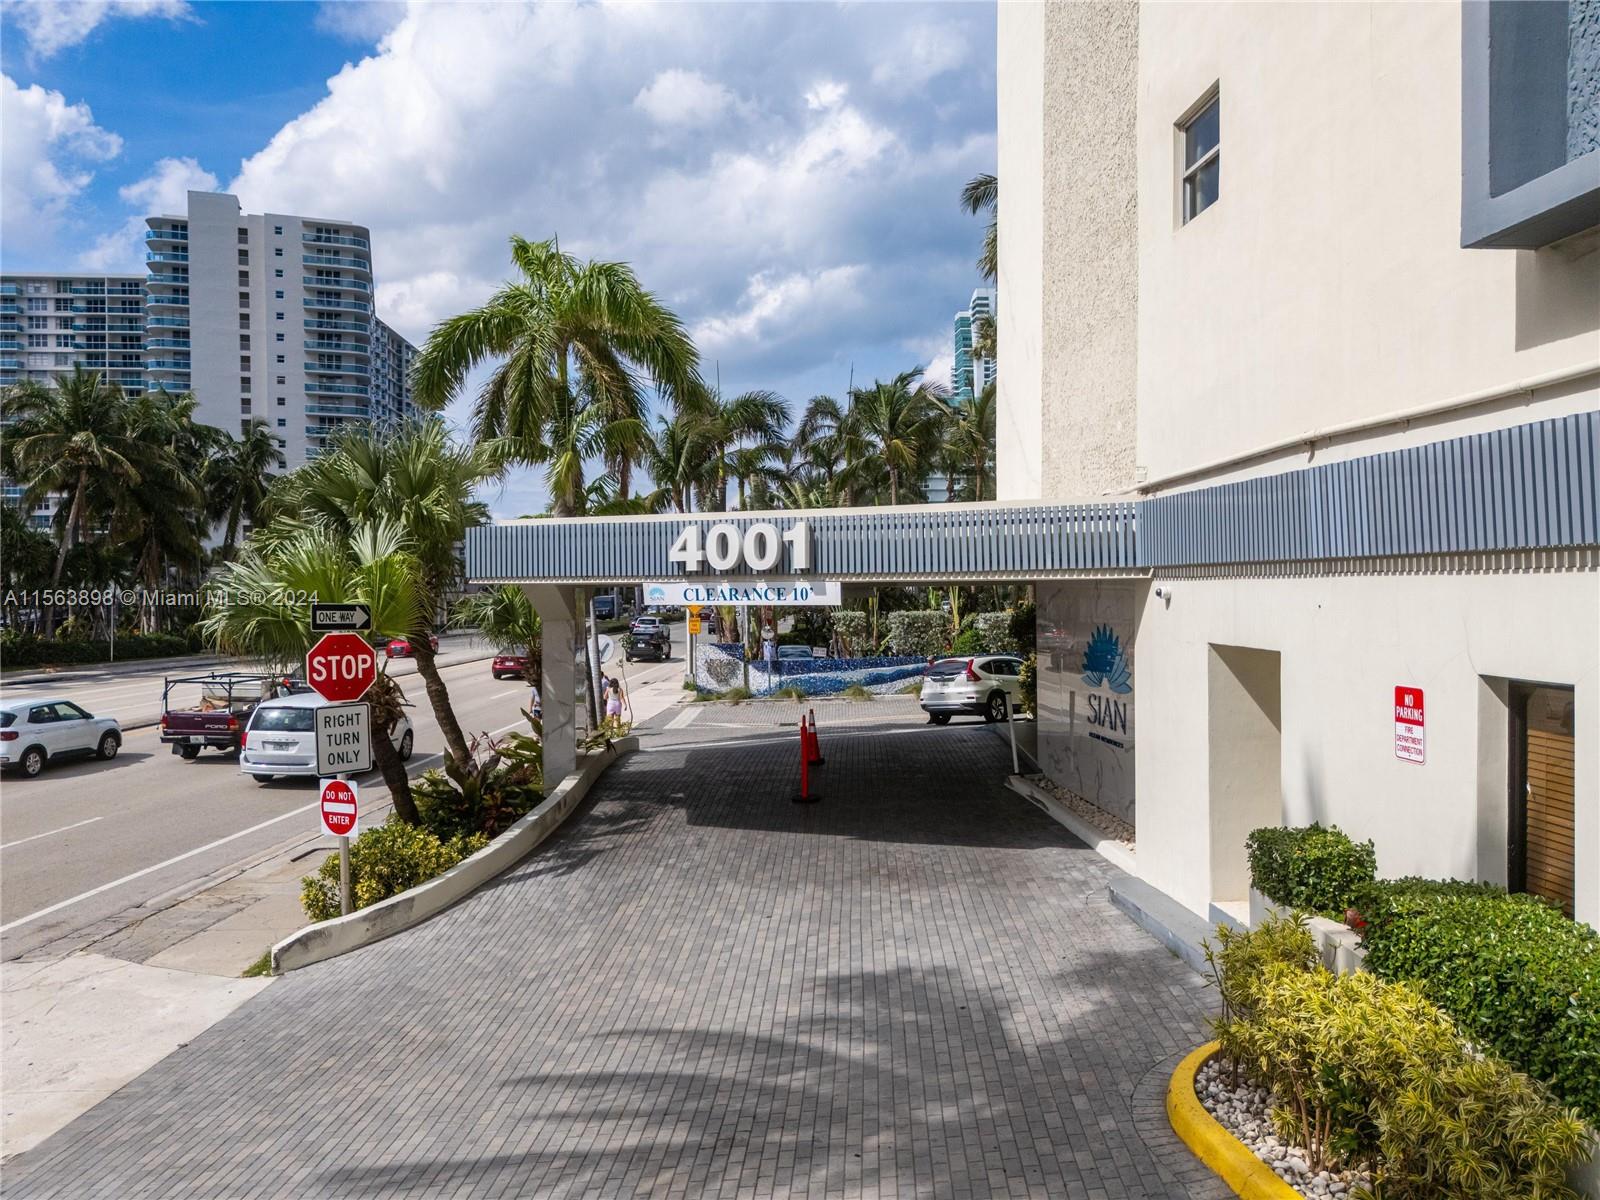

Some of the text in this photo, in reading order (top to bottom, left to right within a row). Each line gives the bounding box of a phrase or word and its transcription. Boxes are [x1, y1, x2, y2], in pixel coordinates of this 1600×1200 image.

[669, 522, 810, 571] 4001
[683, 587, 787, 602] CLEARANCE
[318, 611, 355, 623] ONE WAY
[312, 654, 372, 681] STOP
[1404, 694, 1414, 707] NO
[323, 712, 361, 729] RIGHT
[1087, 693, 1127, 735] SIAN
[1396, 705, 1423, 721] PARKING
[1404, 726, 1414, 734] FIRE
[326, 730, 360, 747] TURN
[1396, 734, 1423, 746] DEPARTMENT
[1396, 743, 1423, 756] CONNECTION
[327, 749, 361, 766] ONLY
[325, 790, 352, 801] DO NOT
[328, 814, 350, 825] ENTER
